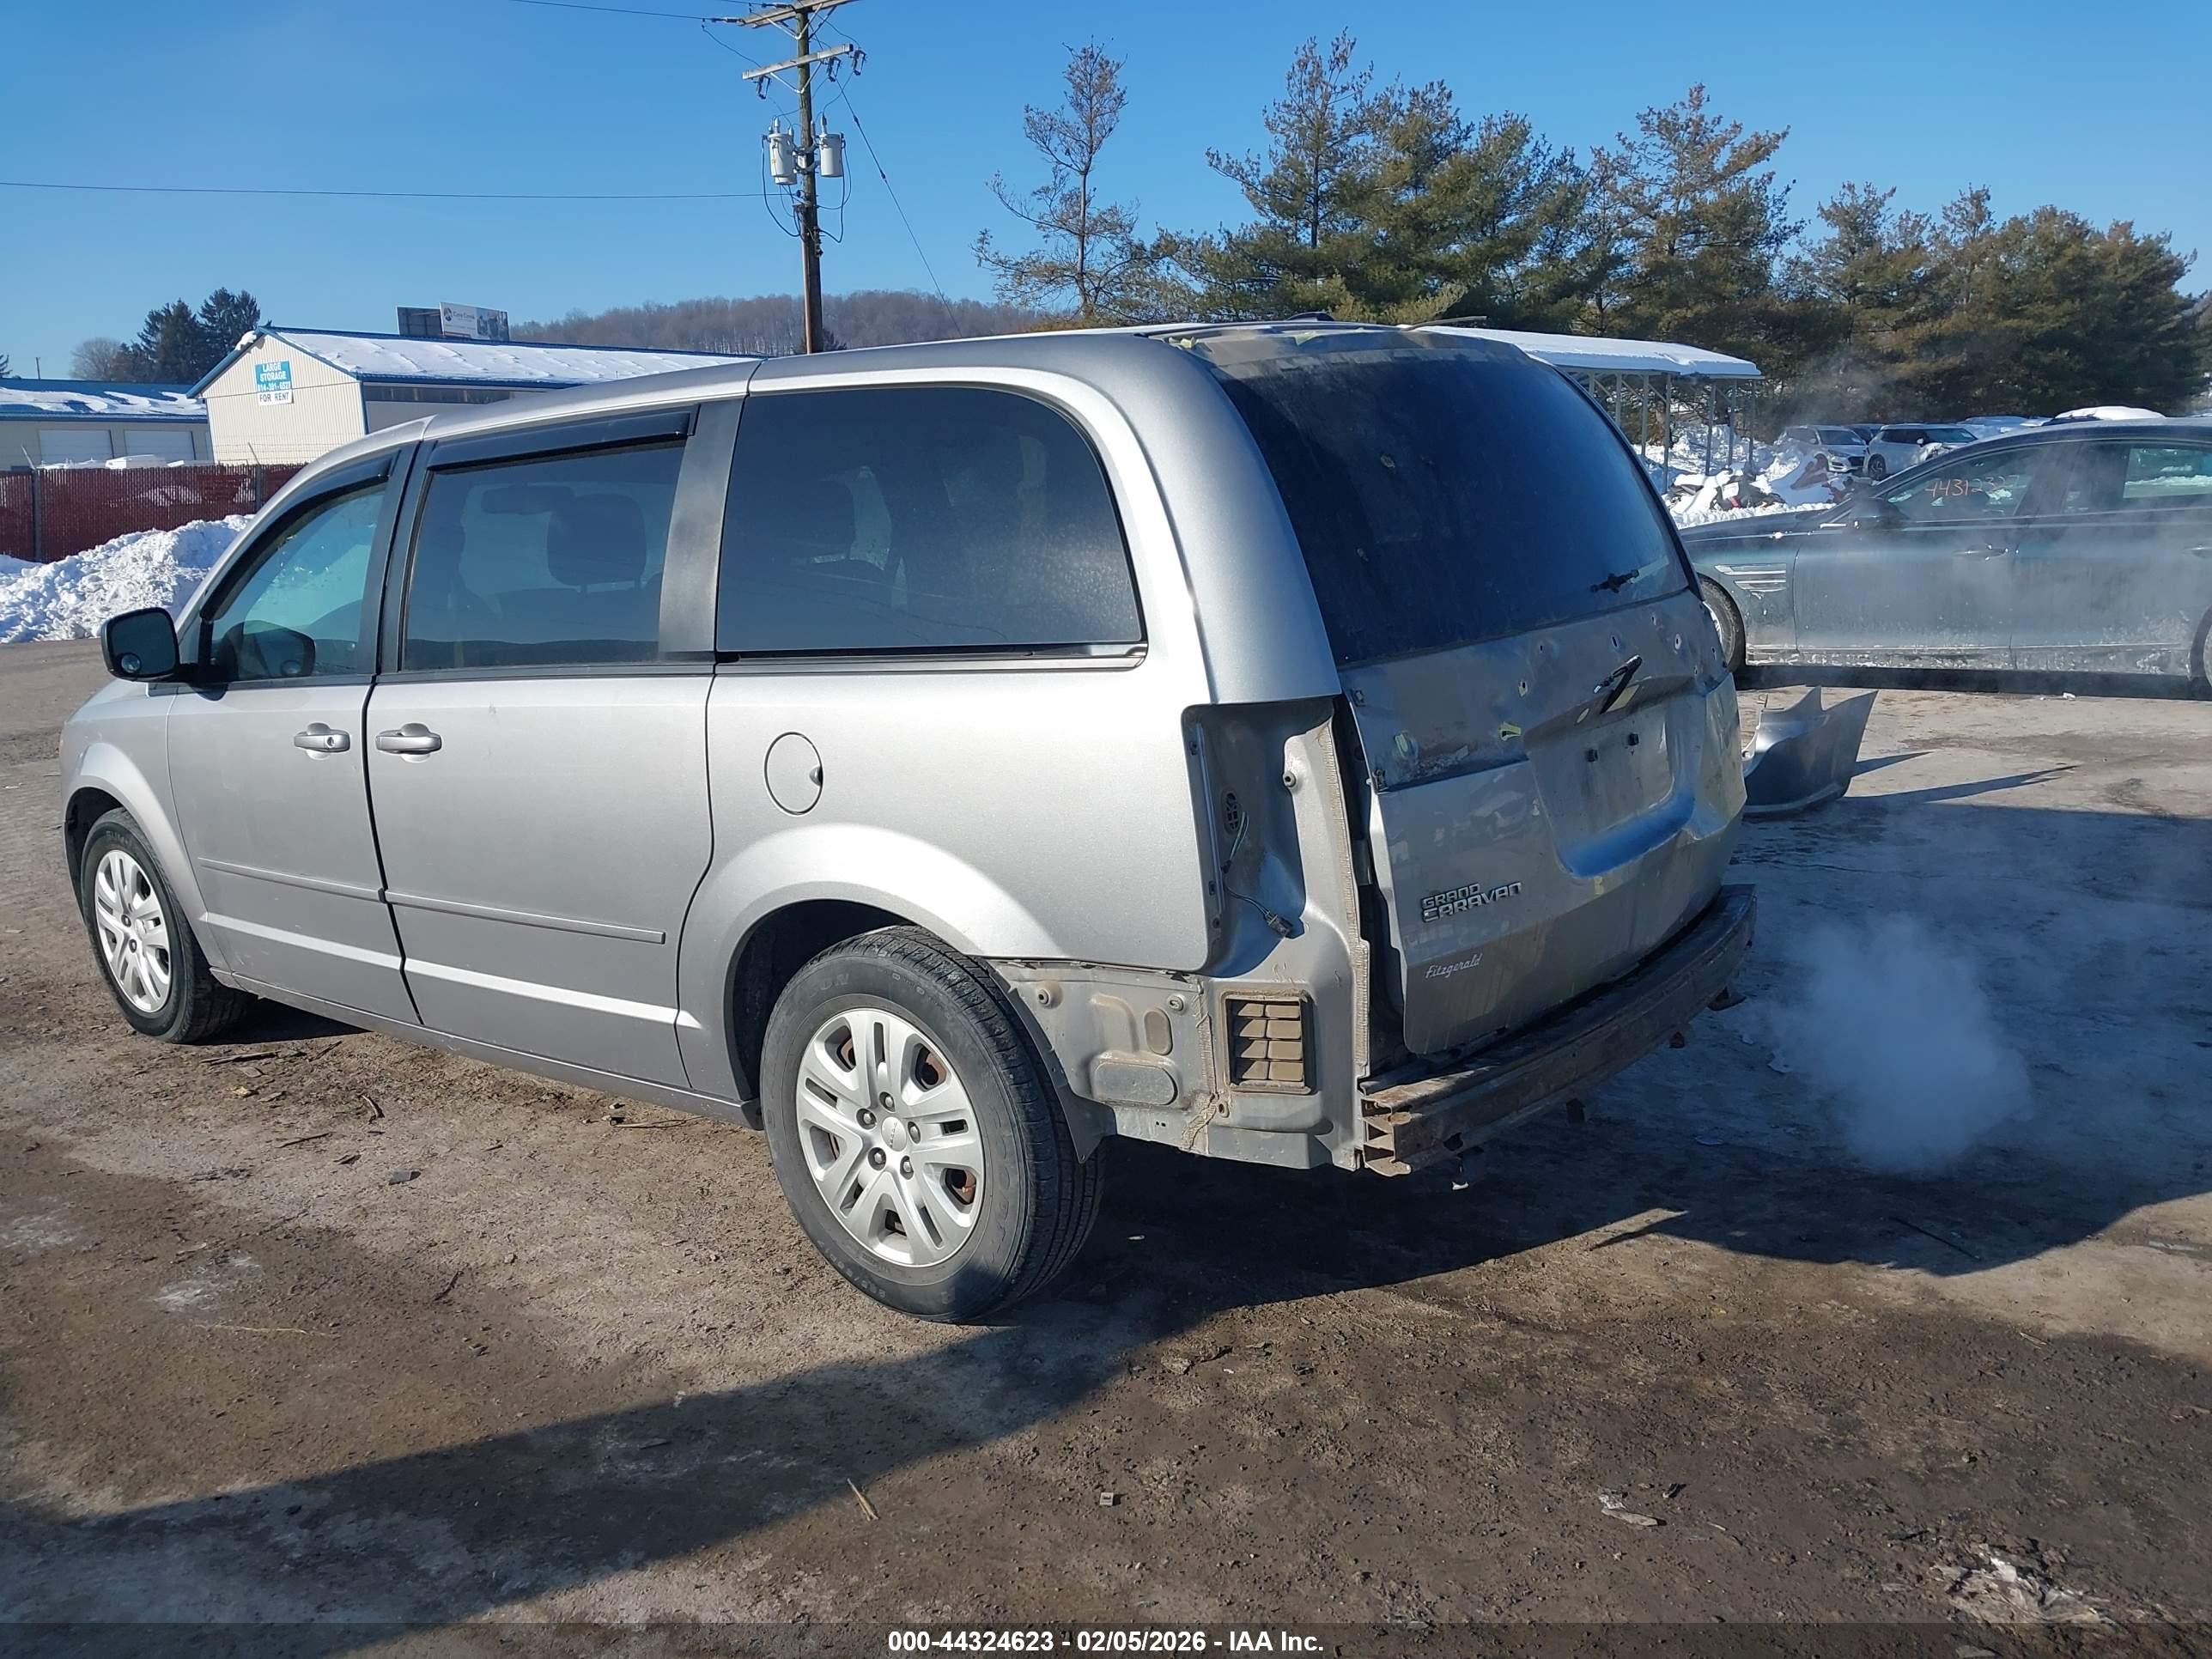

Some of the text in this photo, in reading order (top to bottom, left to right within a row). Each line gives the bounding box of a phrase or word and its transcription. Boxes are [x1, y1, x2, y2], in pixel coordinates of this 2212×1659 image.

[259, 370, 287, 382] STORAGE
[262, 362, 282, 373] LARGE
[259, 392, 289, 403] FOR RENT
[1422, 883, 1480, 908] GRAND
[1423, 881, 1522, 922] CARAVAN
[1425, 952, 1484, 979] Fitzgerald
